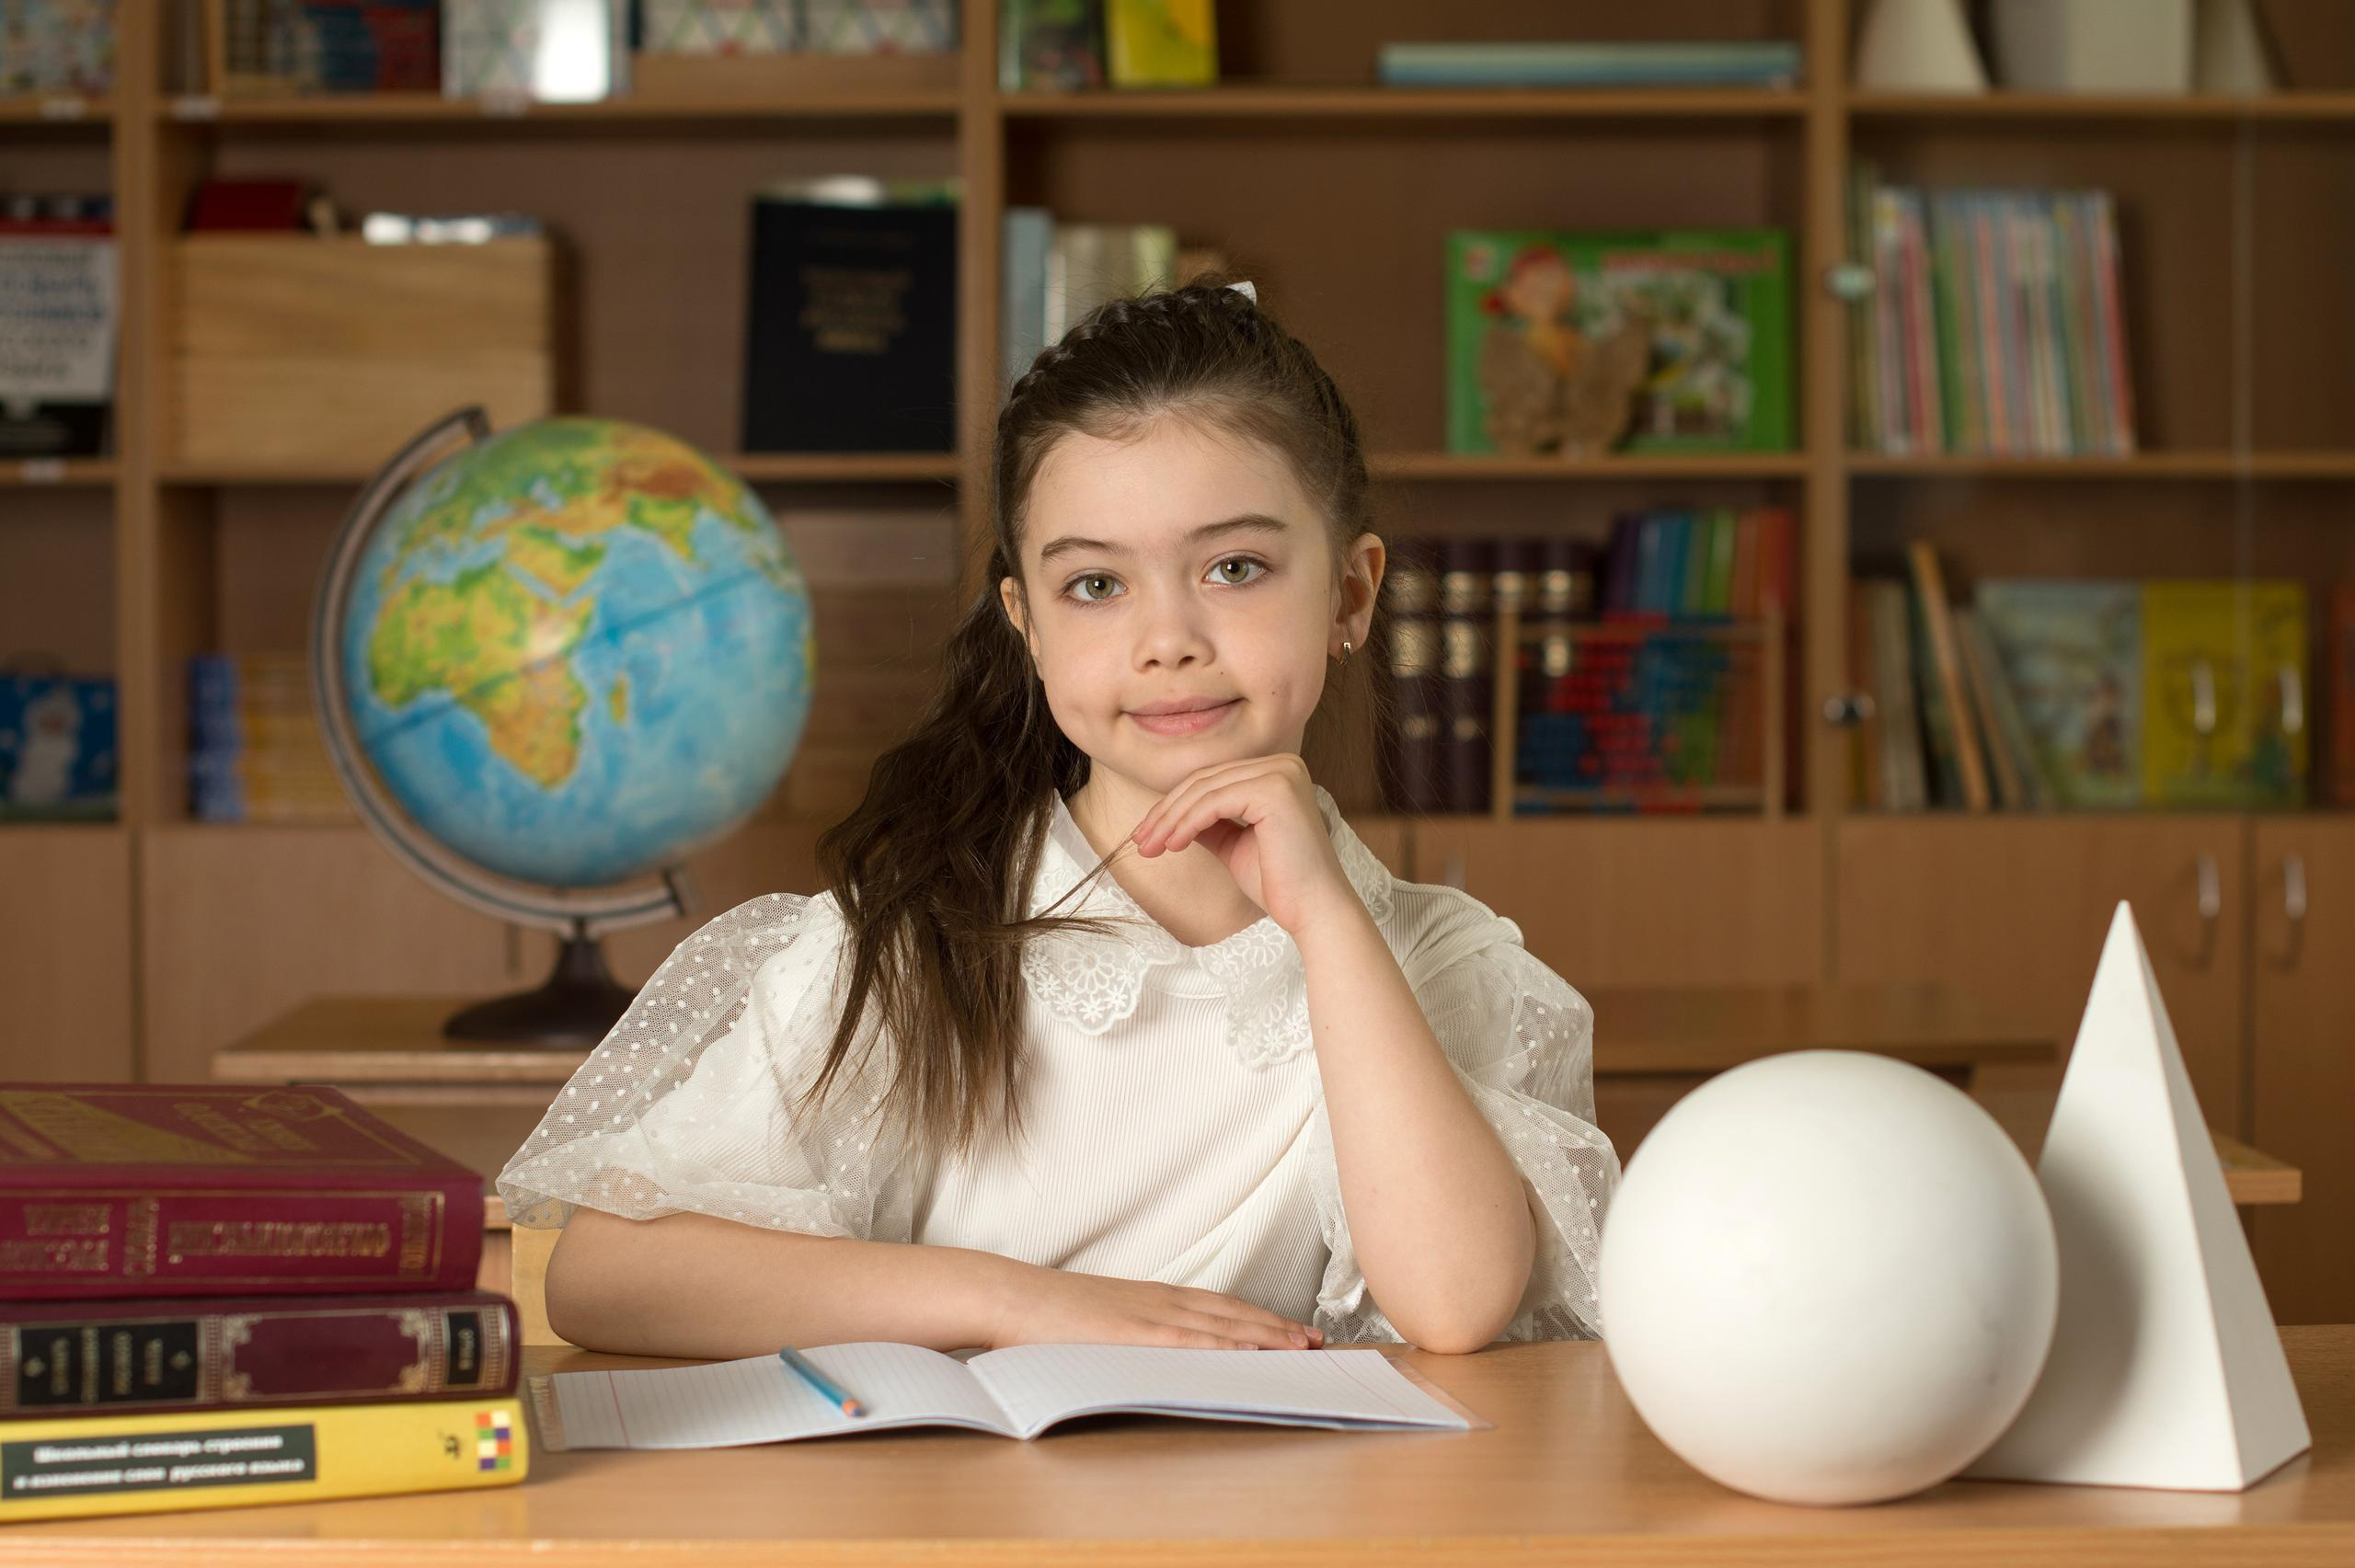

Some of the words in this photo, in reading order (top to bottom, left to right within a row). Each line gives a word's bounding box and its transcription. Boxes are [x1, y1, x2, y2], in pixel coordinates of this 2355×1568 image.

[34, 1441, 131, 1463] Школьный
[132, 1440, 201, 1458] словарь
[169, 1462, 247, 1482] русского
[248, 1459, 304, 1474] языка
